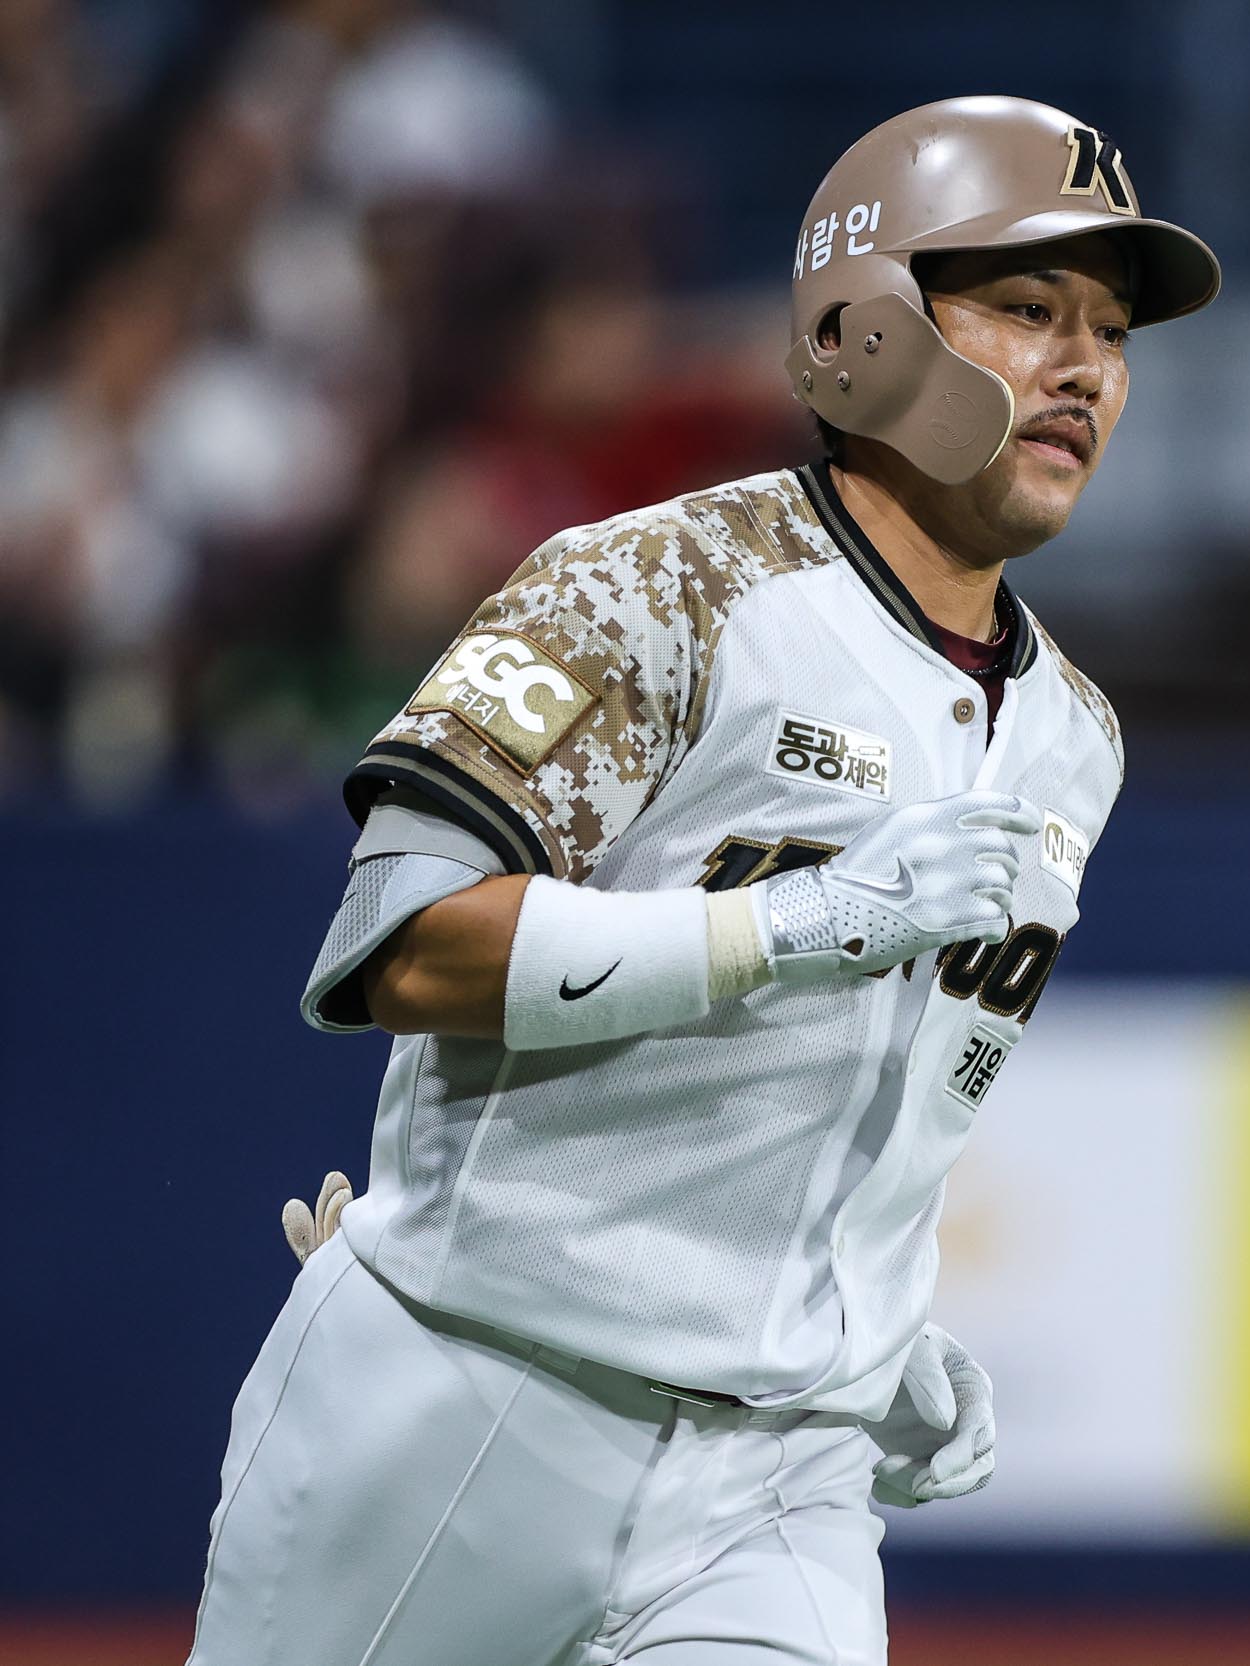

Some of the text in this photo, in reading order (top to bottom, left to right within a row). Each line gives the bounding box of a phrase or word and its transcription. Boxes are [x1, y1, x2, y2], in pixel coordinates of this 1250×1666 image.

[1060, 124, 1136, 216] K
[793, 201, 881, 280] 사람인
[437, 634, 574, 733] SGC
[954, 1037, 1006, 1104] 키움
